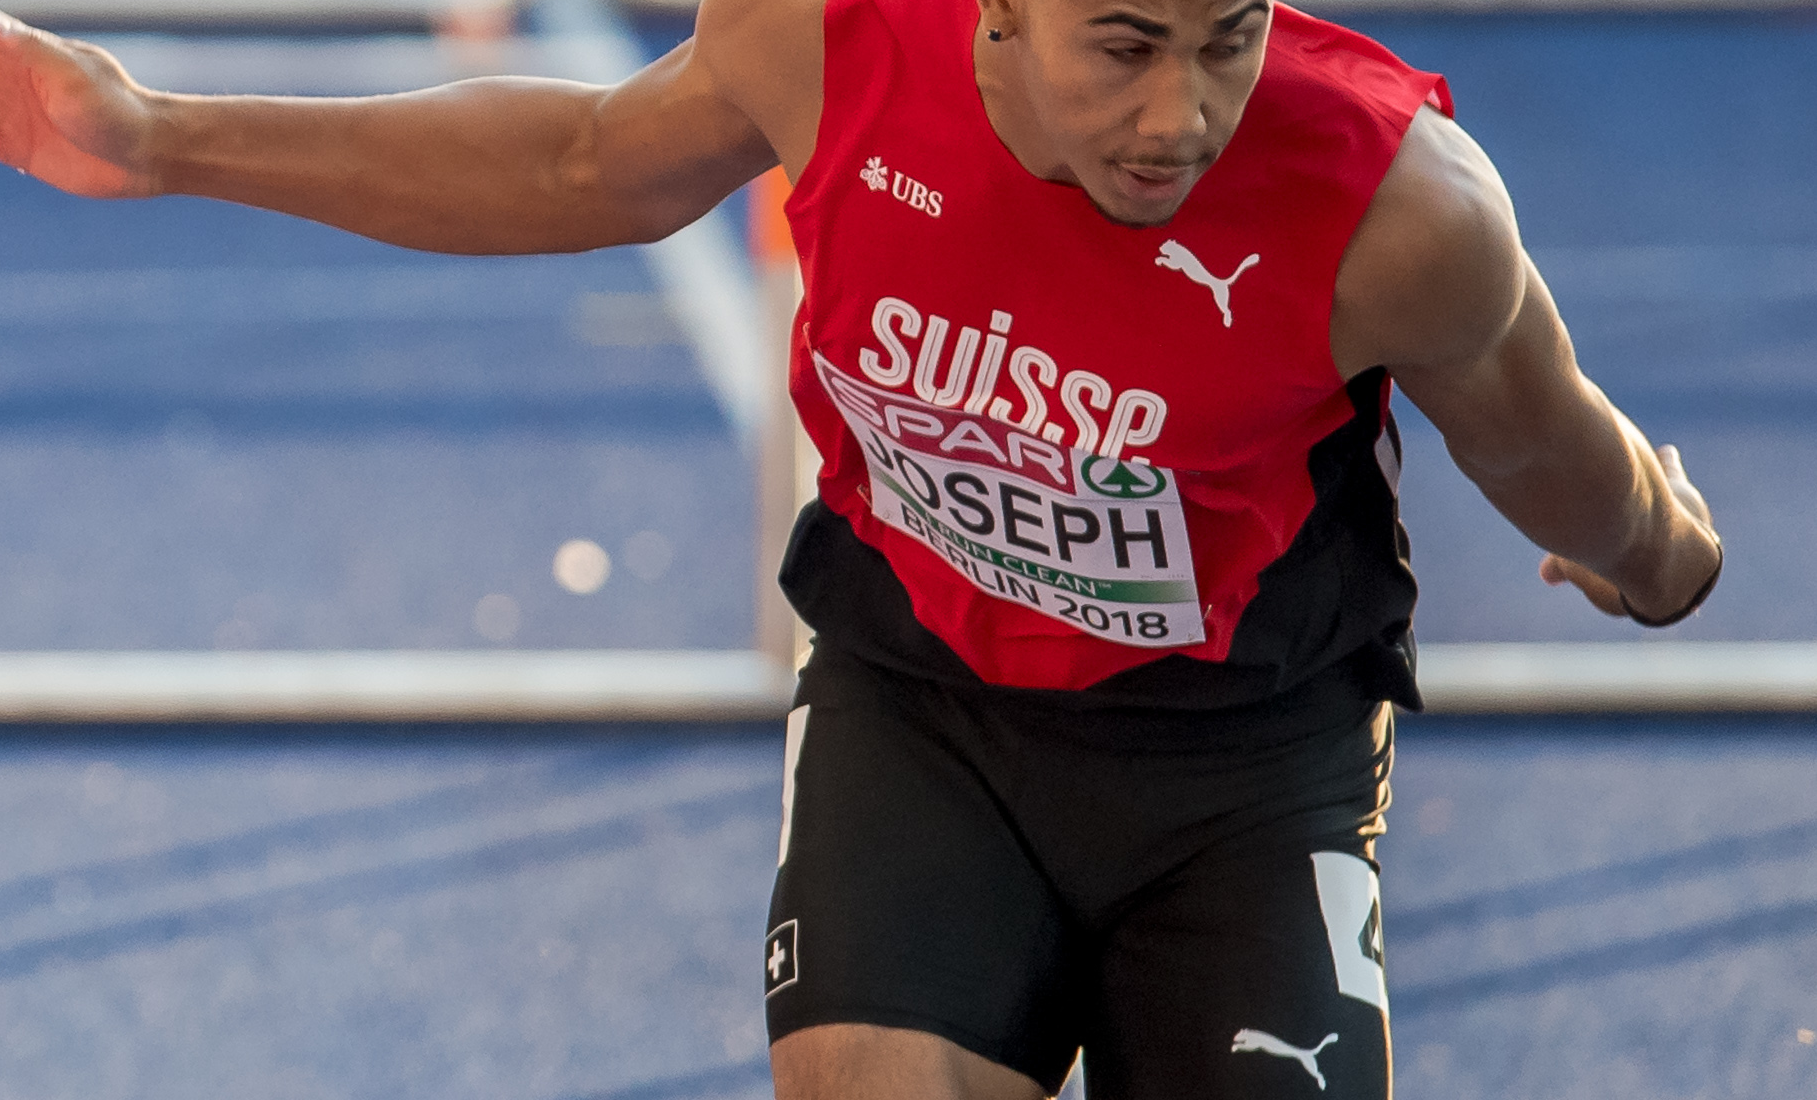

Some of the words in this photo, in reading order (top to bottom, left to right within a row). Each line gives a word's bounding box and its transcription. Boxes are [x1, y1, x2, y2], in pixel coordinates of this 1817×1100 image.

[891, 170, 944, 219] UBS
[831, 376, 1068, 486] SPAR
[865, 426, 1170, 569] JOSEPH
[937, 522, 994, 563] RUN
[900, 503, 1042, 607] BERLIN
[1054, 594, 1170, 639] 2018
